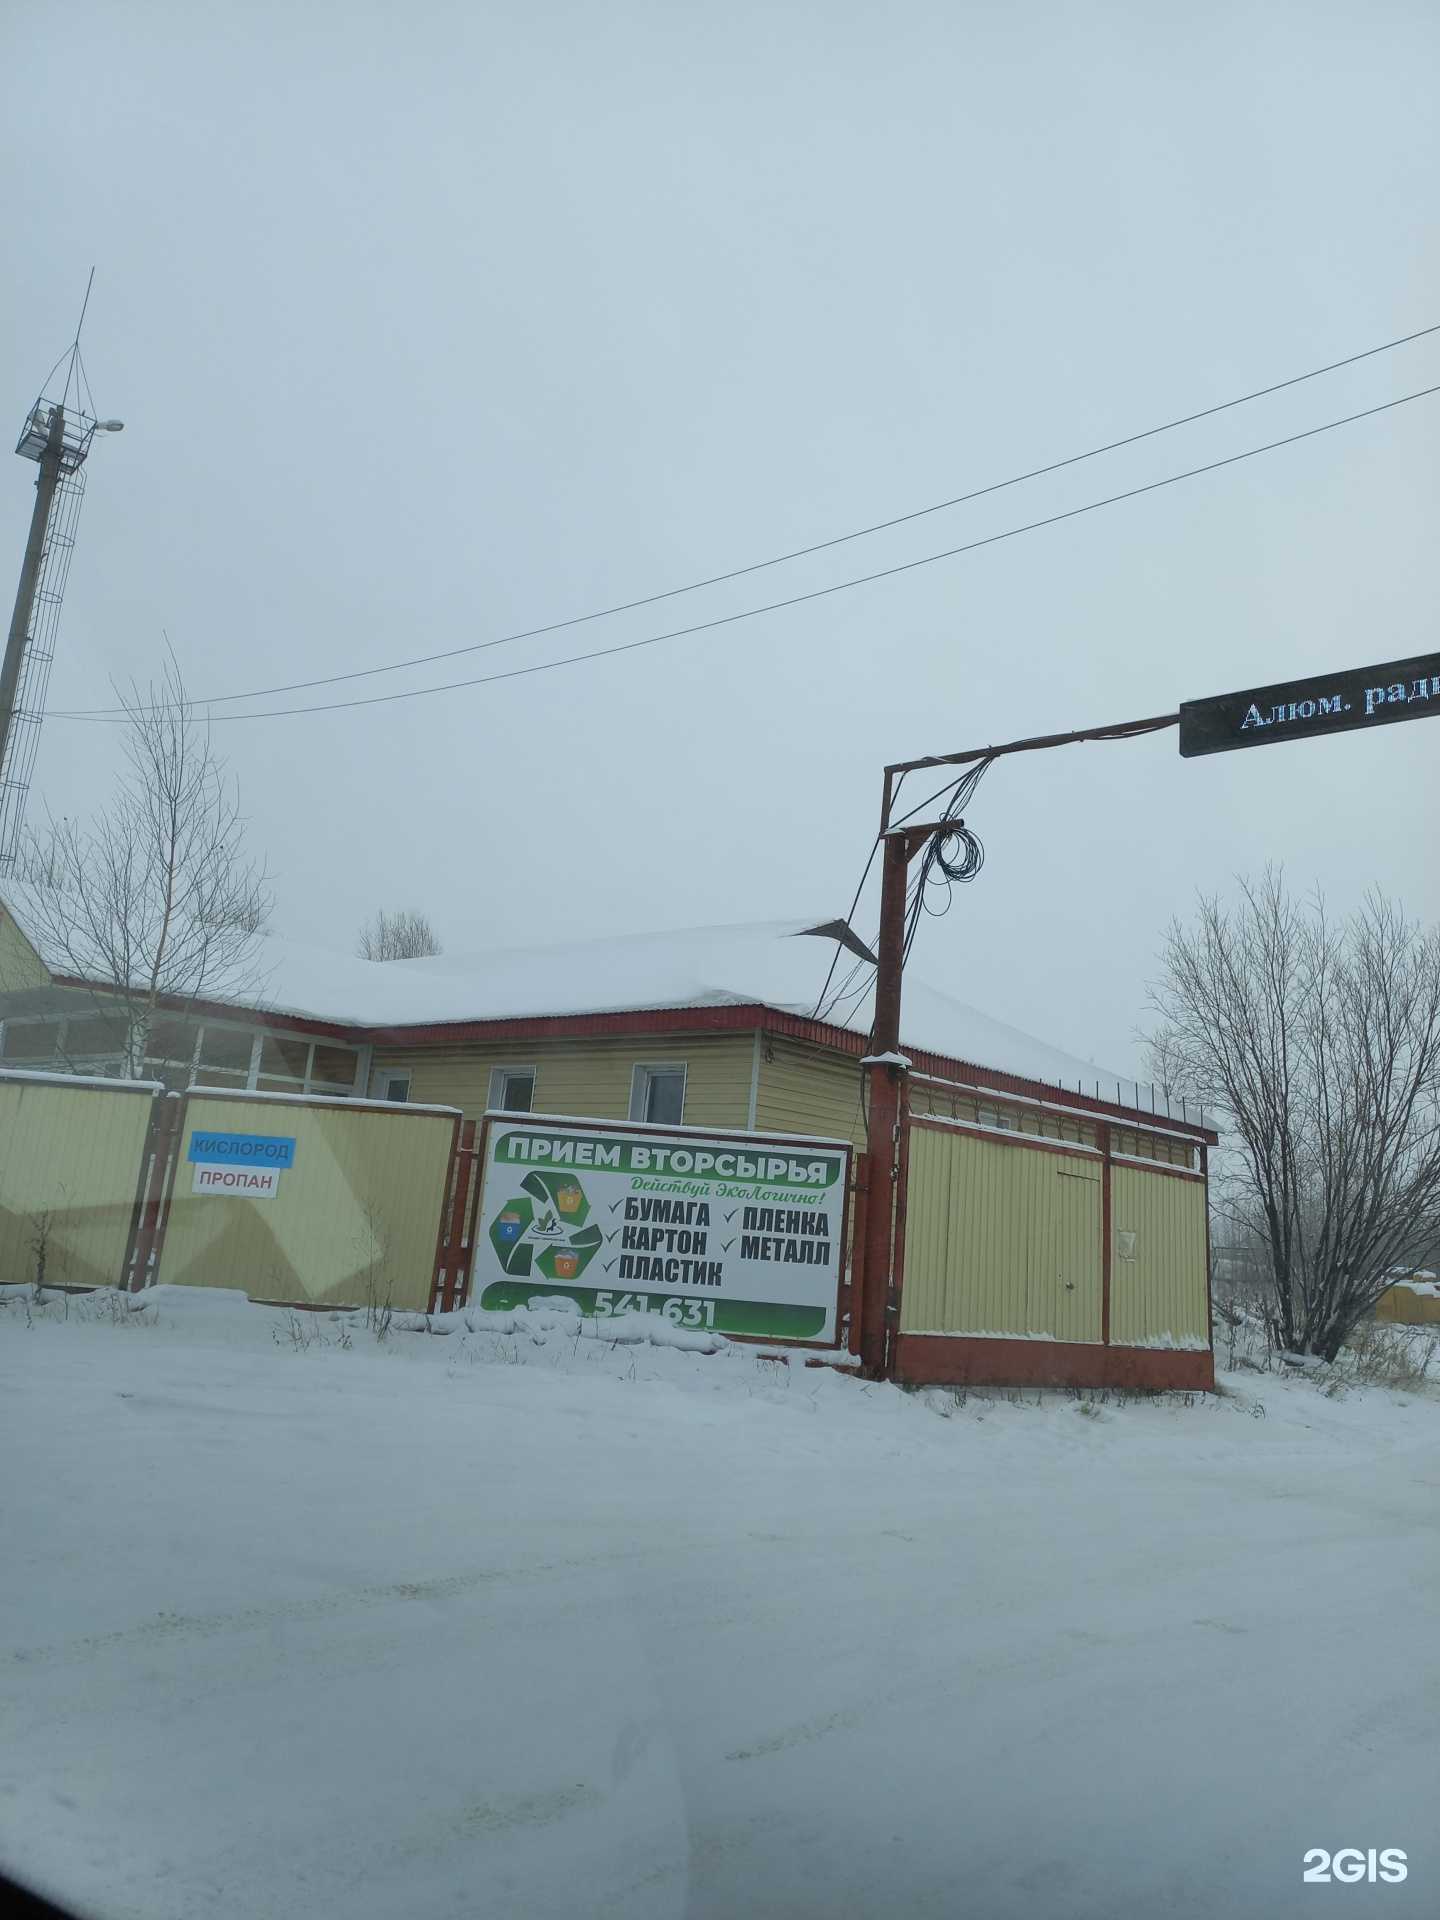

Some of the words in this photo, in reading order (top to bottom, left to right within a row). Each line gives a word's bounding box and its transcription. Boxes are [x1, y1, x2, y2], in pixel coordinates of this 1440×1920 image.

[1240, 694, 1351, 729] Алюм.
[194, 1139, 289, 1160] КИСЛОРОД
[507, 1136, 620, 1169] ПРИЕМ
[630, 1147, 828, 1185] ВТОРСЫРЬЯ
[200, 1171, 273, 1189] ПРОПАН
[624, 1197, 711, 1227] БУМАГА
[742, 1206, 829, 1237] ПЛЕНКА
[621, 1225, 707, 1255] КАРТОН
[740, 1236, 831, 1266] МЕТАЛЛ
[618, 1255, 723, 1287] ПЛАСТИК
